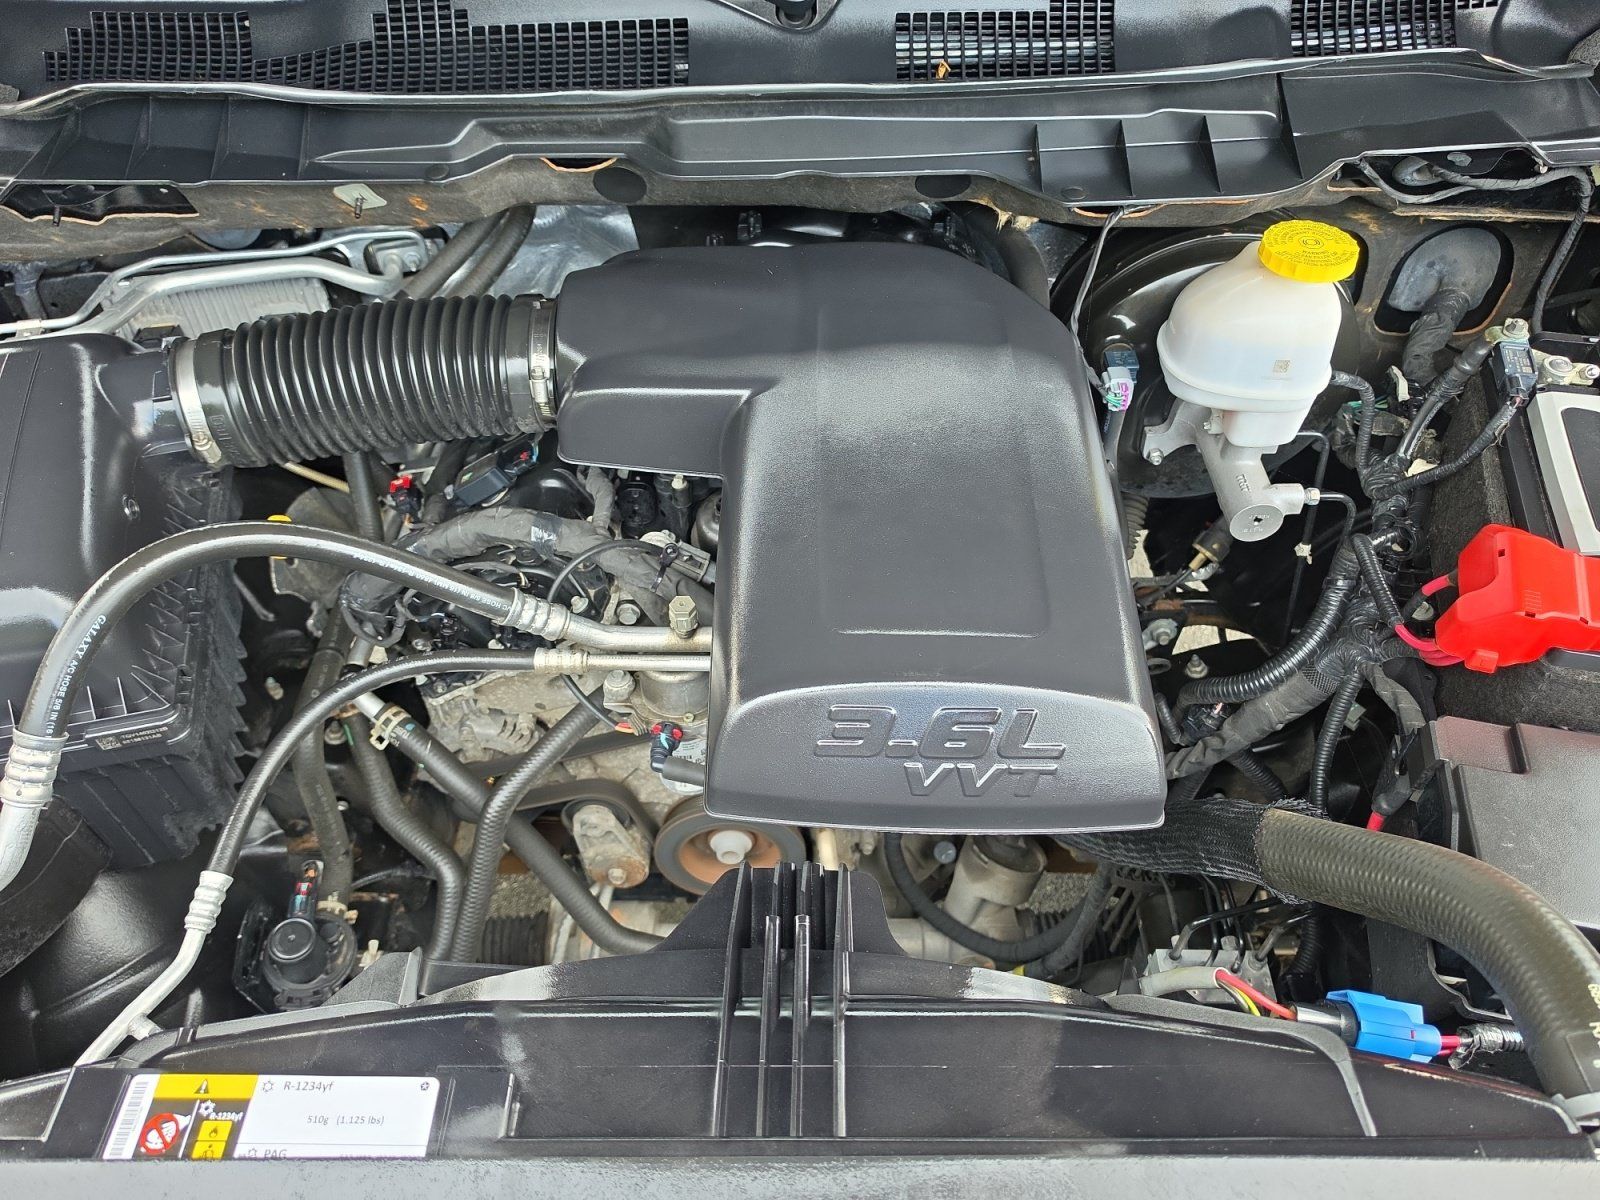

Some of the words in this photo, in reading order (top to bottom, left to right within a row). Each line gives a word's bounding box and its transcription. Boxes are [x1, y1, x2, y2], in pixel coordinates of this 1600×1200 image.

[480, 597, 502, 608] HOSE
[75, 614, 107, 659] GALAXY
[67, 659, 79, 674] A/C
[57, 674, 73, 698] HOSE
[53, 698, 63, 710] 5/8
[50, 711, 59, 721] IN
[813, 704, 1067, 759] 3.6L
[904, 762, 1058, 797] VVT
[283, 1080, 334, 1092] R-1234yf
[306, 1115, 329, 1125] 510g
[336, 1115, 366, 1126] (1.125
[367, 1115, 385, 1126] lbs)
[263, 1148, 288, 1159] PAG
